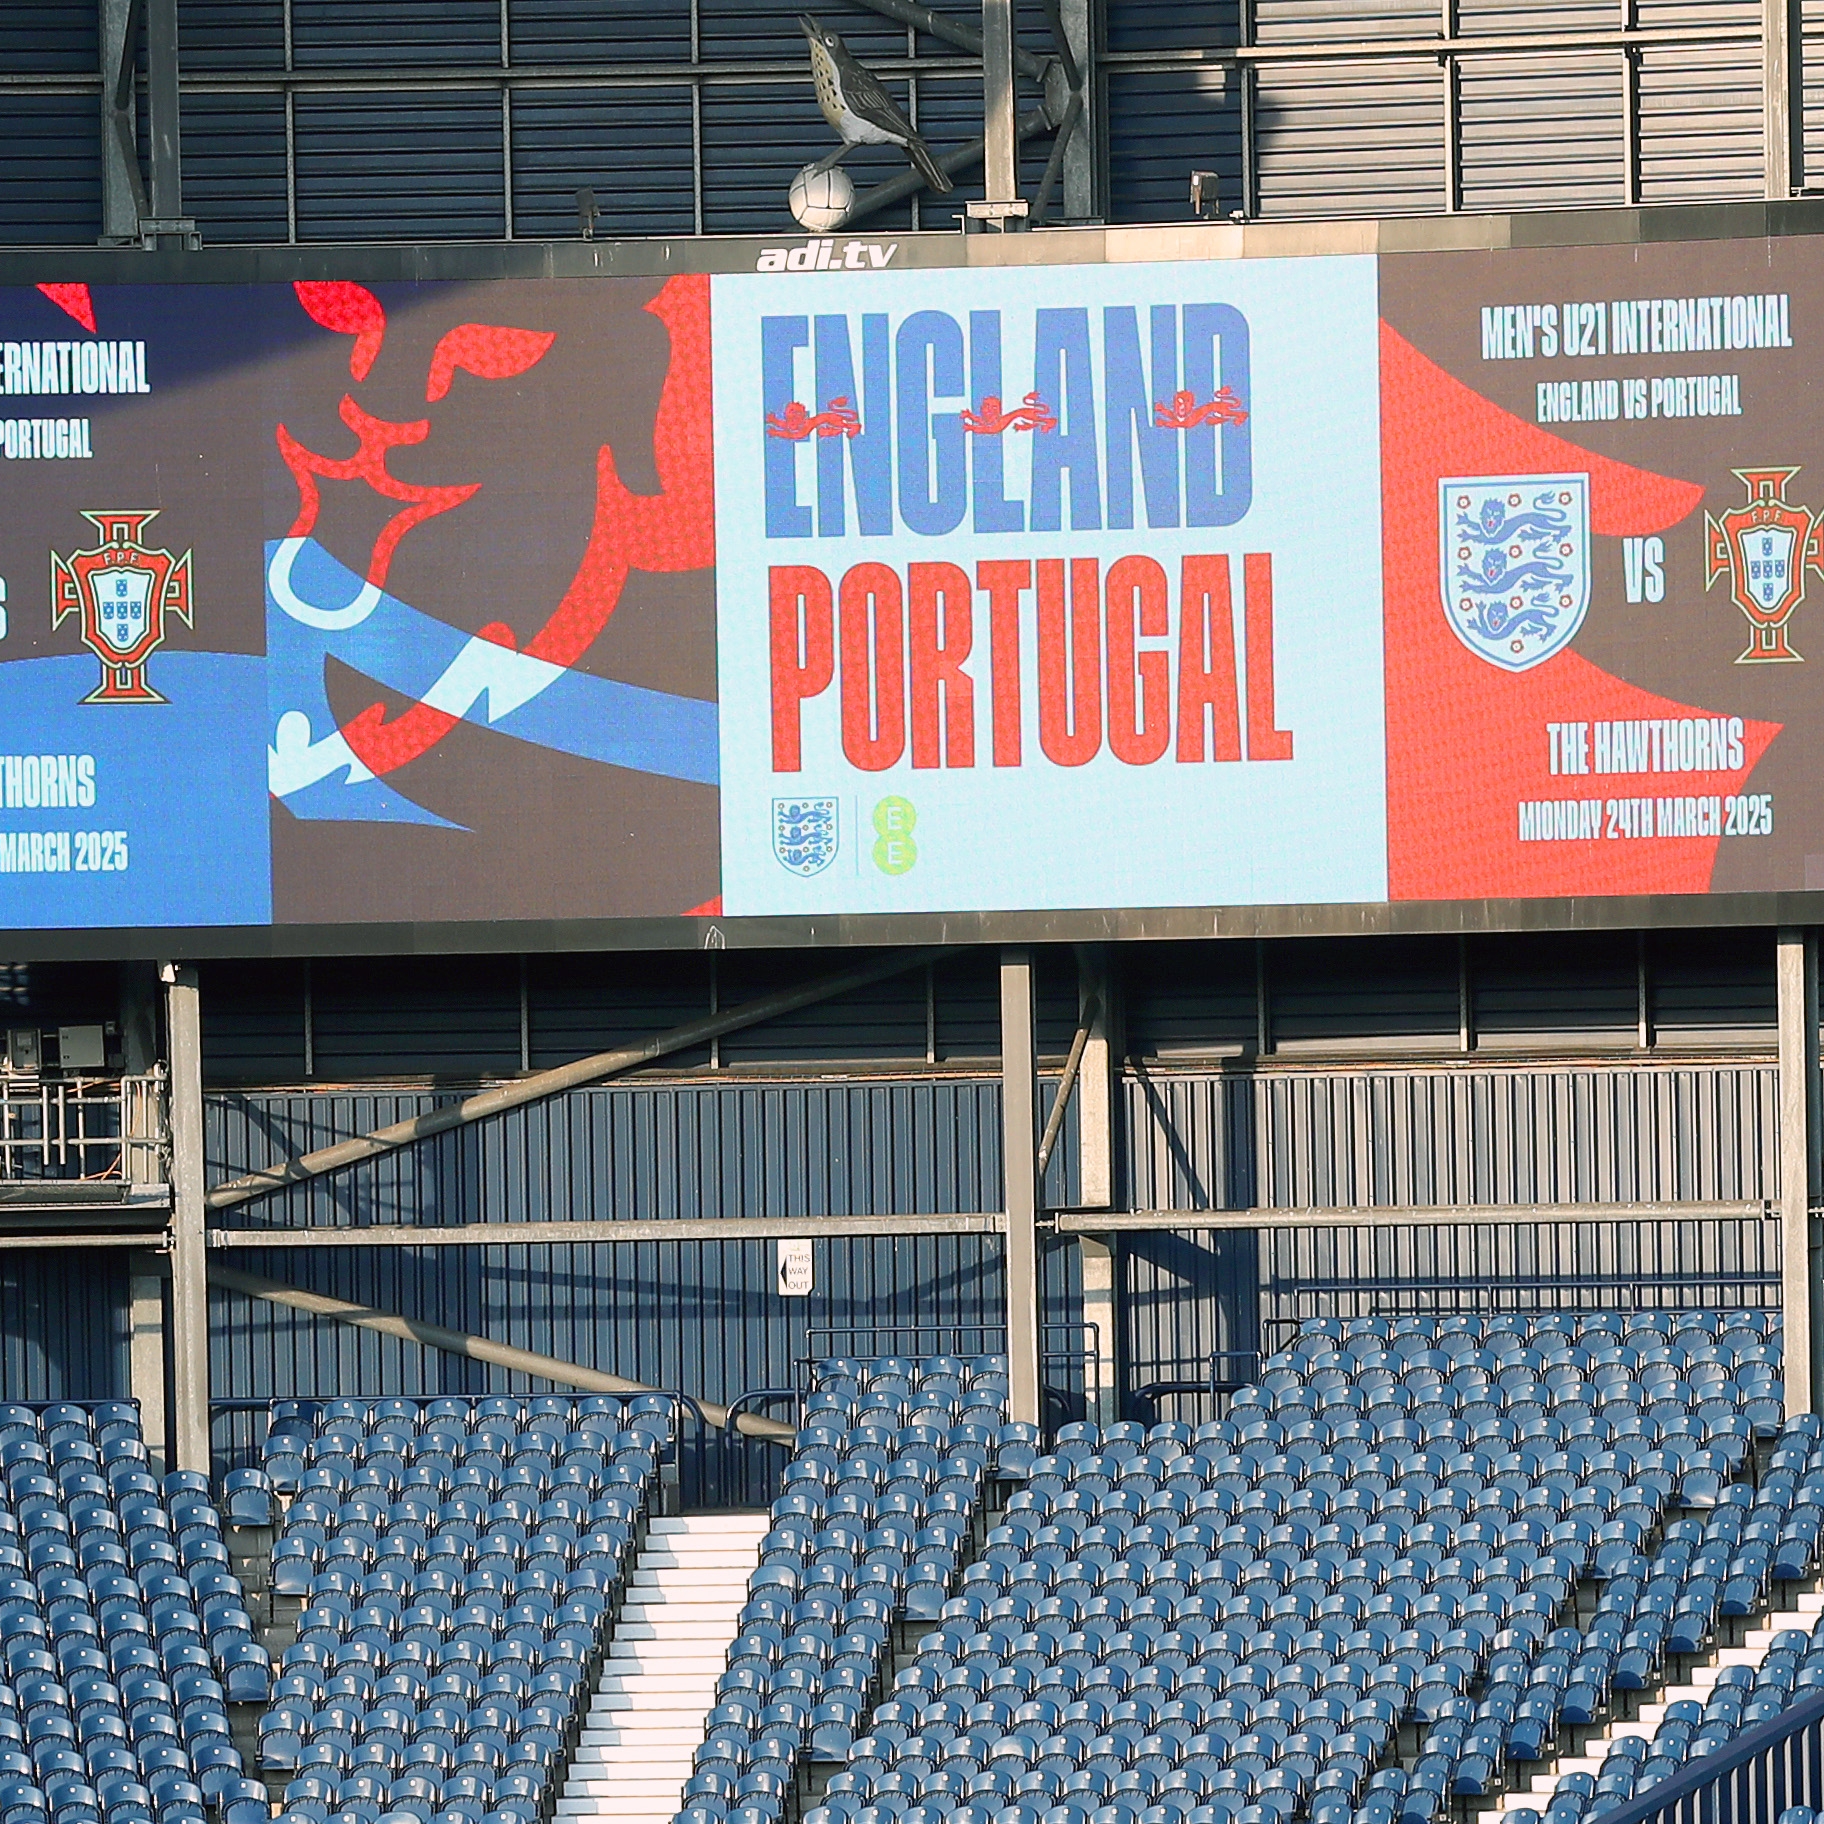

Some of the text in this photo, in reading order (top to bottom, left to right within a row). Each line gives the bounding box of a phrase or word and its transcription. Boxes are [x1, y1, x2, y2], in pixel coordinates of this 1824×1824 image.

[756, 239, 898, 272] adi.tv
[1481, 294, 1793, 360] MEN'S U21 INTERNATIONAL
[761, 302, 1253, 539] ENGLAND
[1536, 374, 1743, 423] ENGLAND VS PORTUGAL
[1623, 537, 1666, 603] VS
[768, 552, 1294, 773] PORTUGAL
[1546, 716, 1744, 775] THE HAWTHORNS
[1606, 798, 1654, 839] 24TH
[1656, 796, 1722, 838] MARCH
[1724, 794, 1774, 836] 2025
[75, 831, 128, 872] 2025
[788, 1254, 811, 1263] THIS
[788, 1267, 809, 1275] WAY
[788, 1281, 809, 1290] OUT
